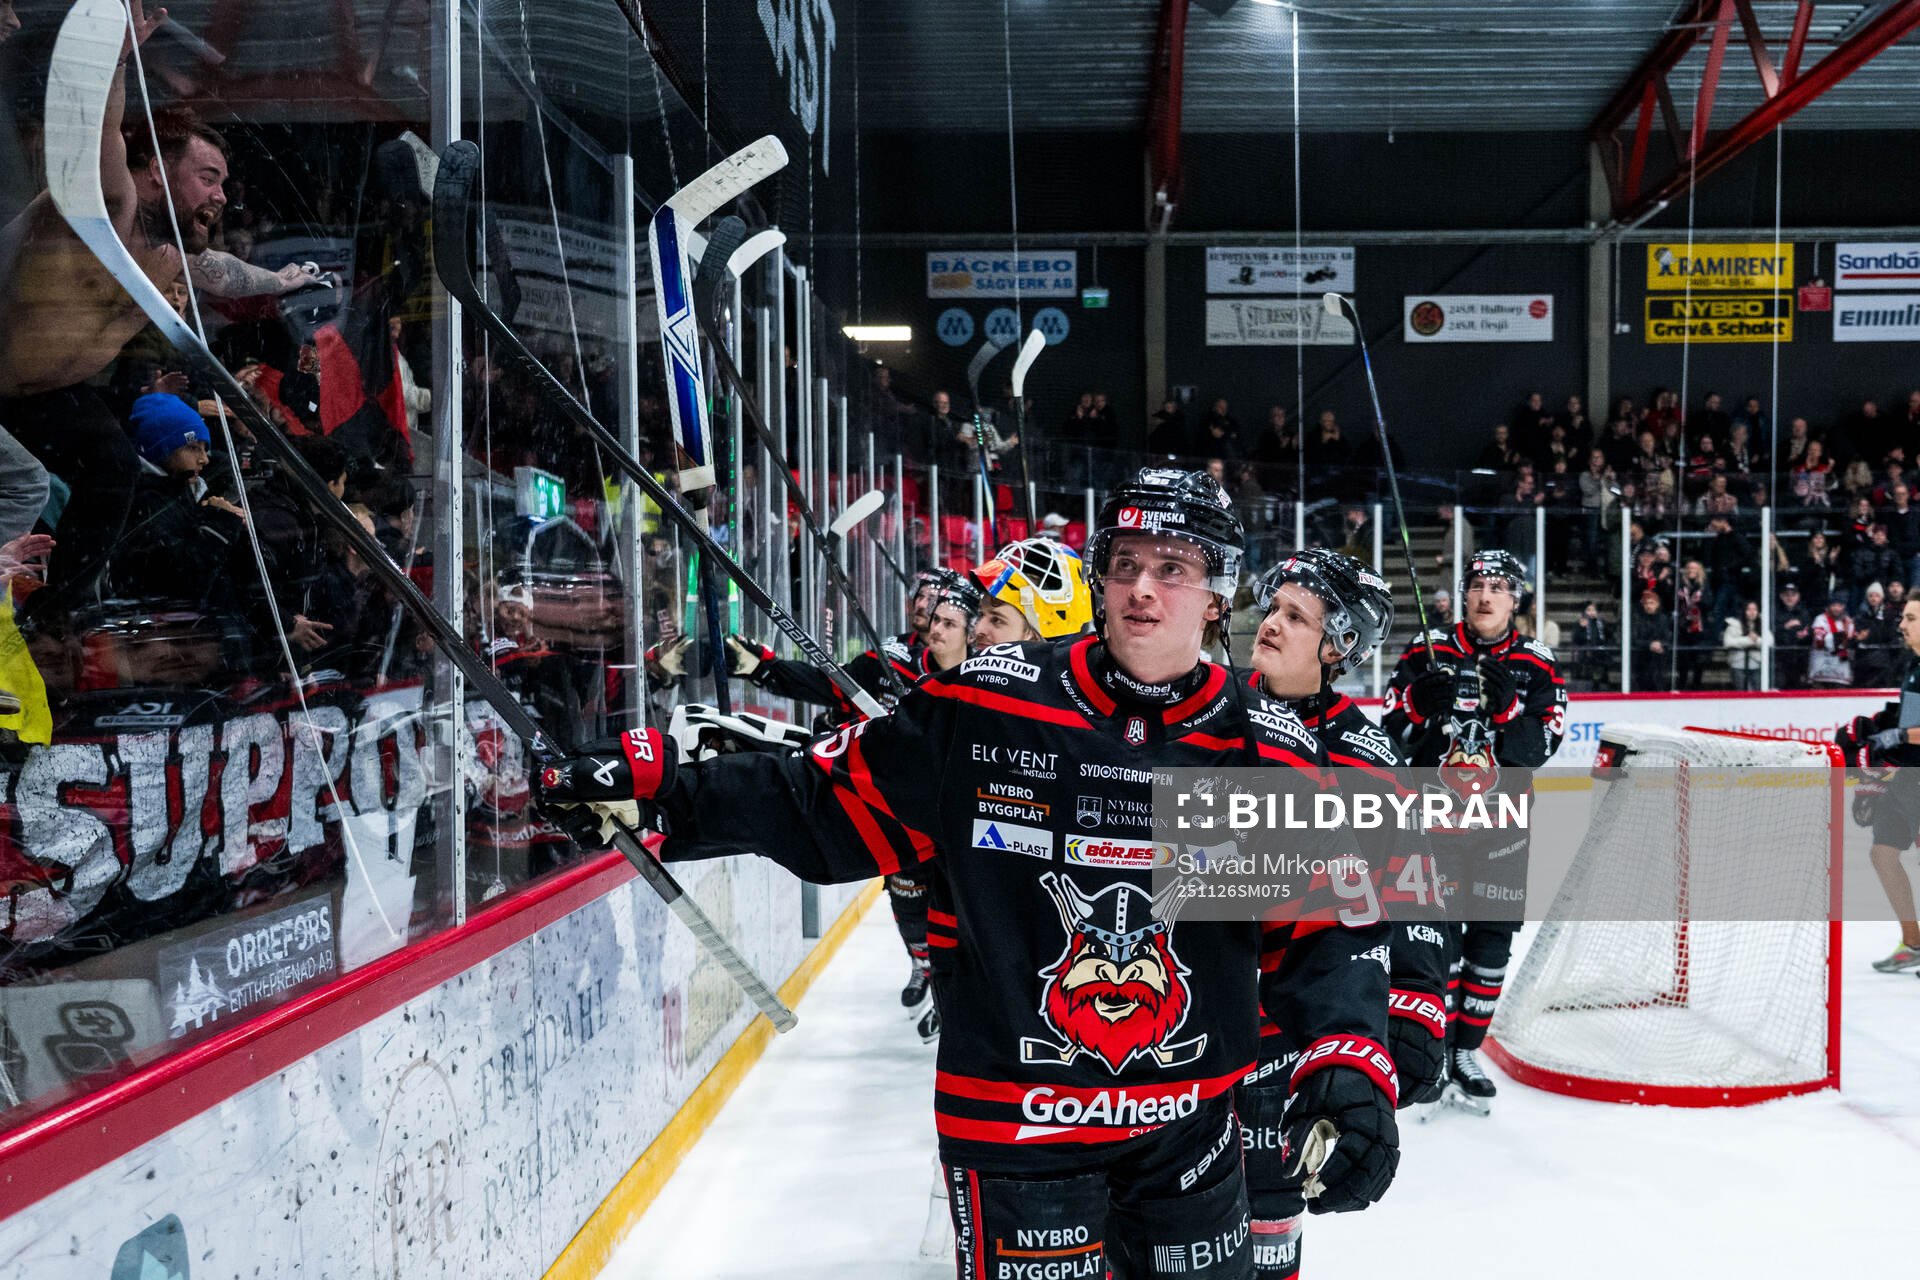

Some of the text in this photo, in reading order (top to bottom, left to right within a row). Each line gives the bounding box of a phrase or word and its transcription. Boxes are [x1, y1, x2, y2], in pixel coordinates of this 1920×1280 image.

[930, 256, 1073, 273] BÄCKEBO
[1678, 256, 1787, 276] RAMIRENT
[975, 276, 1073, 290] SÅGVERK AB
[1671, 301, 1766, 317] NYBRO
[1716, 320, 1786, 336] Schakt
[1140, 520, 1163, 531] SPEL
[1141, 509, 1186, 525] SVENSKA
[980, 643, 1026, 661] ICA
[963, 658, 1036, 678] KVANTUM
[976, 674, 1009, 686] NYBRO
[1114, 670, 1171, 695] amokabel
[1259, 699, 1306, 730] ICA
[1265, 730, 1297, 748] NYBRO
[1358, 724, 1392, 750] ICA
[1345, 733, 1396, 763] KVANTUM
[1352, 746, 1376, 762] NYBRO
[1023, 769, 1057, 780] INSTALCO
[1080, 763, 1174, 786] SYDOSTGRUPPEN
[989, 782, 1034, 800] NYBRO
[978, 801, 1044, 822] BYGGPLÅT
[1107, 799, 1155, 815] NYBRO
[1106, 813, 1169, 829] KOMMUN
[1085, 841, 1158, 861] BÖRJES
[1121, 859, 1151, 867] SPEDITION
[1331, 856, 1381, 928] 9
[1485, 883, 1525, 902] Bitus
[226, 905, 332, 979] ORREFORS
[228, 949, 334, 1014] ENTREPRENAD AB
[1388, 993, 1448, 1030] AUER
[1243, 1050, 1301, 1087] BAUE
[1022, 1083, 1201, 1125] GoAhead
[1017, 1225, 1089, 1248] NYBRO
[1191, 1212, 1249, 1270] Bitus
[998, 1252, 1101, 1280] BYGGPLÅT
